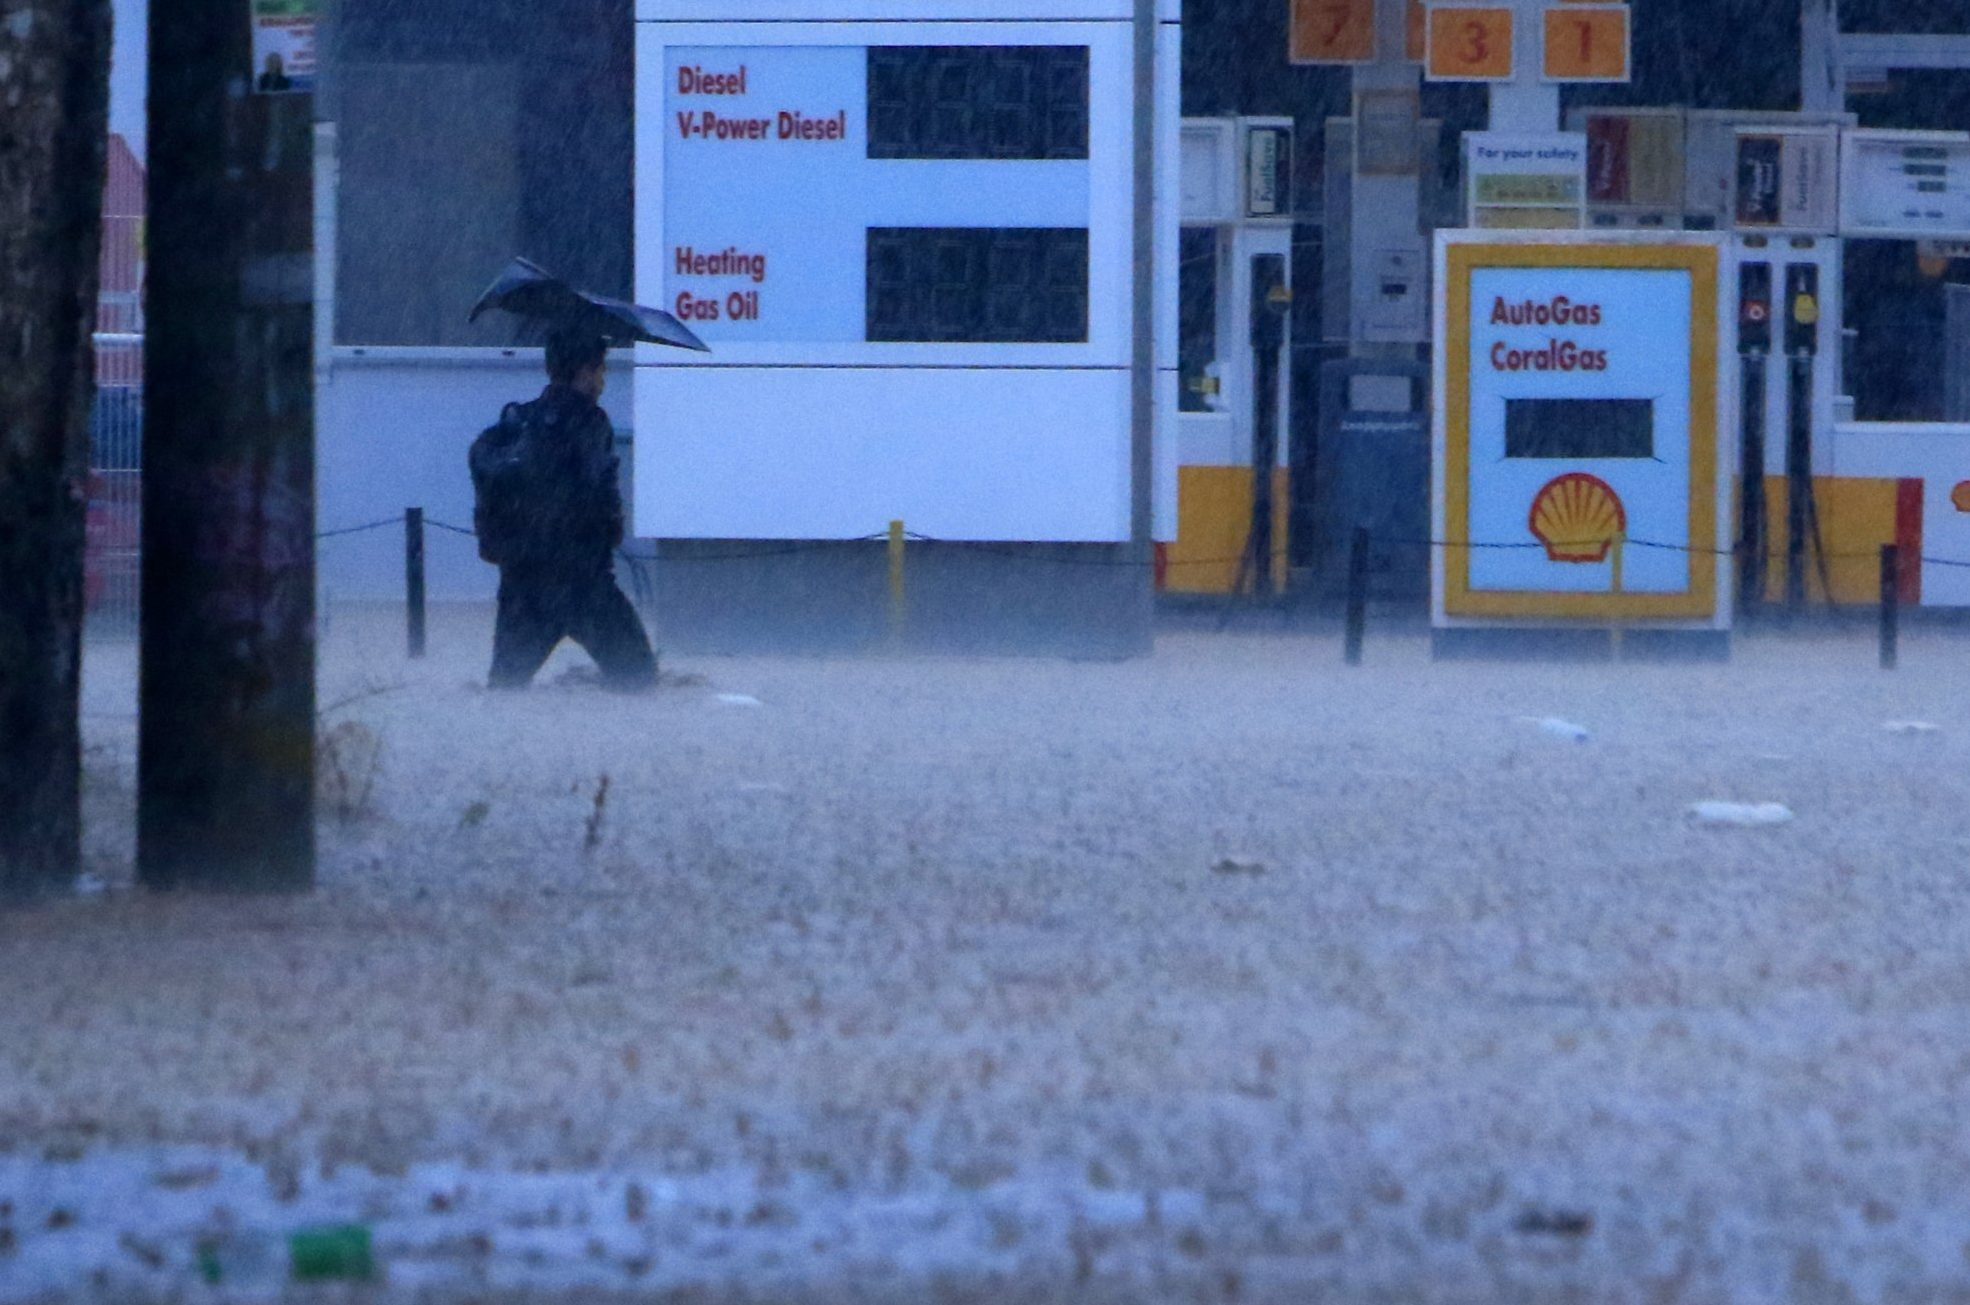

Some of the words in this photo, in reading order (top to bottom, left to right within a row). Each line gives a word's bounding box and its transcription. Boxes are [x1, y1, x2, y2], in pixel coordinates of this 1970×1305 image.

[1460, 21, 1488, 64] 3
[1576, 21, 1592, 63] 1
[678, 65, 746, 94] Diesel
[677, 111, 770, 140] V-Power
[778, 110, 846, 140] Diesel
[1478, 146, 1499, 159] For
[1503, 150, 1534, 162] your
[1537, 147, 1579, 162] safety
[676, 246, 765, 283] Heating
[676, 291, 719, 321] Gas
[726, 290, 759, 321] Oil
[1490, 296, 1602, 325] AutoGas
[1490, 339, 1607, 371] CoralGas
